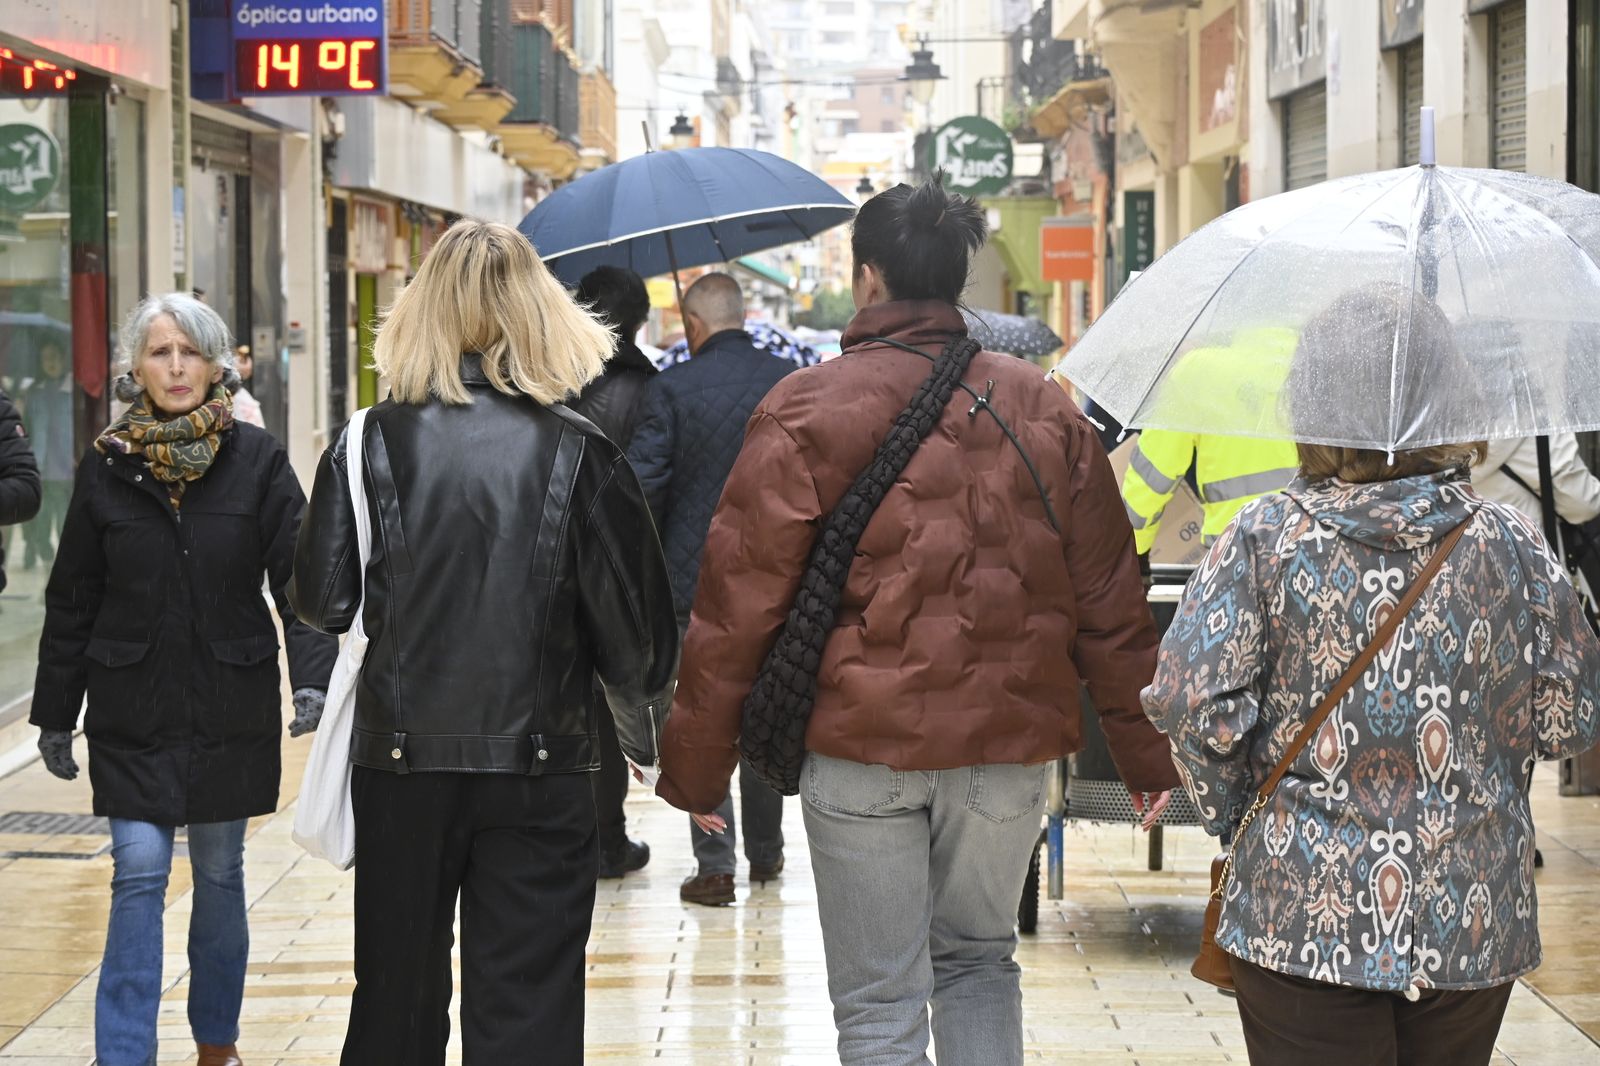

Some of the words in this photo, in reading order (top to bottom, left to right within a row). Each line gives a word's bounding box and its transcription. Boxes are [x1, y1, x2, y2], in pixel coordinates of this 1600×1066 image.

[237, 3, 302, 28] óptica
[305, 3, 378, 23] urbano
[257, 43, 300, 89] 14
